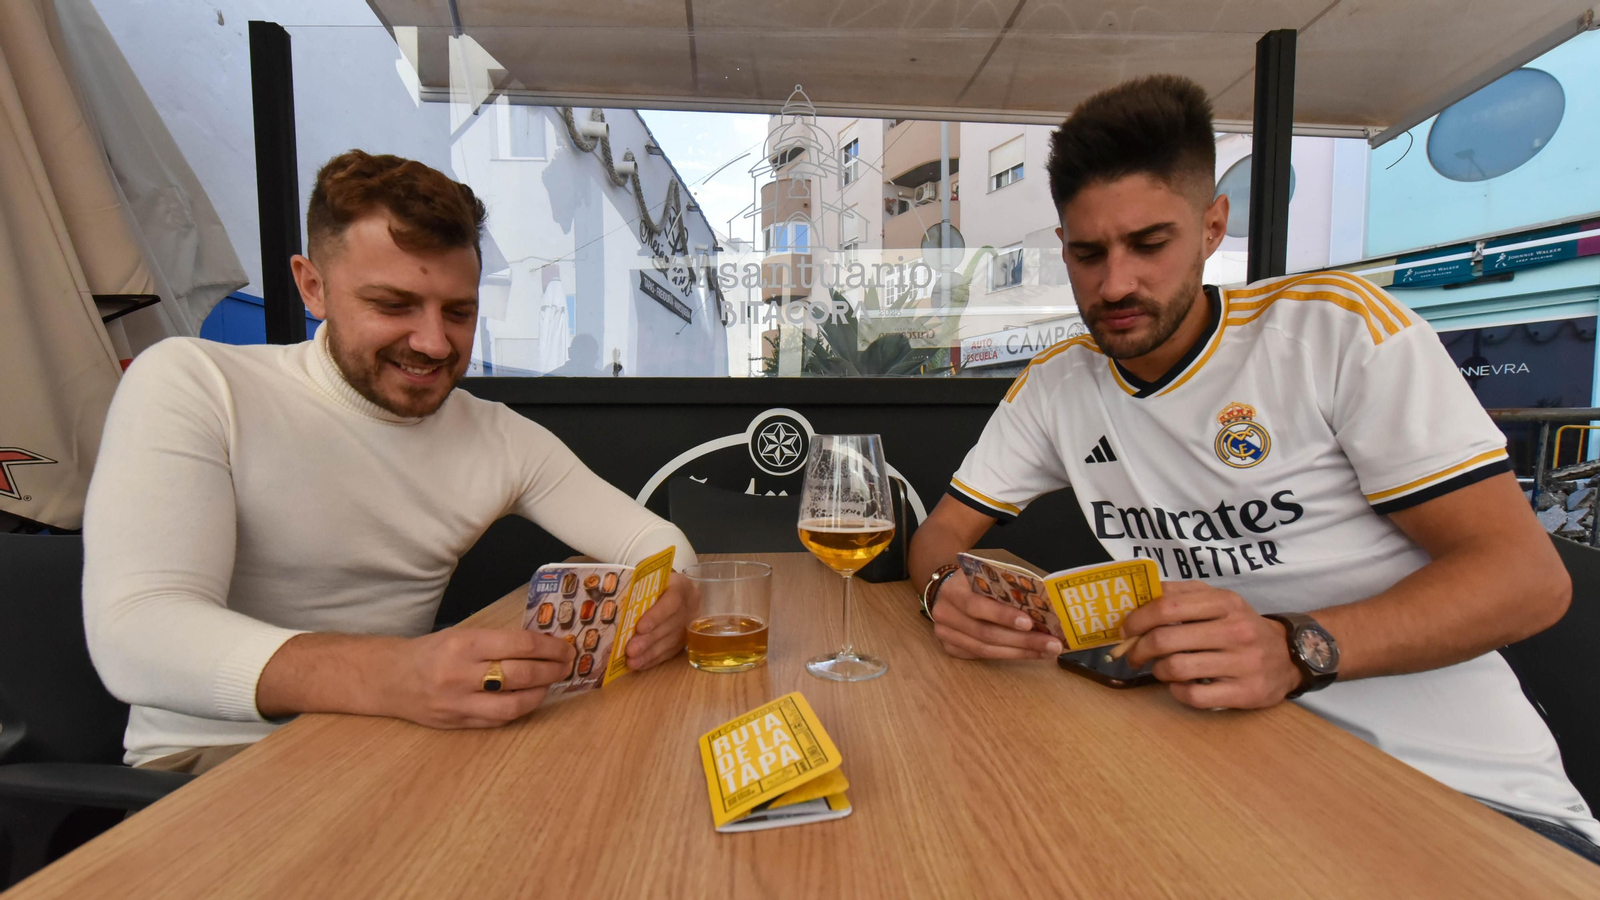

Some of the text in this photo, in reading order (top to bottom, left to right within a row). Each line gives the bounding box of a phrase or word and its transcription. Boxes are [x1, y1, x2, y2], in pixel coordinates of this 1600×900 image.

[1536, 247, 1562, 256] WALKER
[719, 255, 933, 290] santuario
[965, 349, 999, 363] ESCUELA
[971, 337, 993, 350] AUTO
[1090, 489, 1304, 542] Emirates
[1172, 540, 1286, 580] BETTER
[628, 569, 660, 609] RUTA
[1062, 576, 1132, 606] RUTA
[621, 605, 638, 632] DE
[1068, 594, 1135, 621] DE LA
[1074, 611, 1131, 635] TAP
[712, 713, 782, 757] RUTA
[716, 728, 791, 776] DE LA
[721, 744, 801, 794] TAPA
